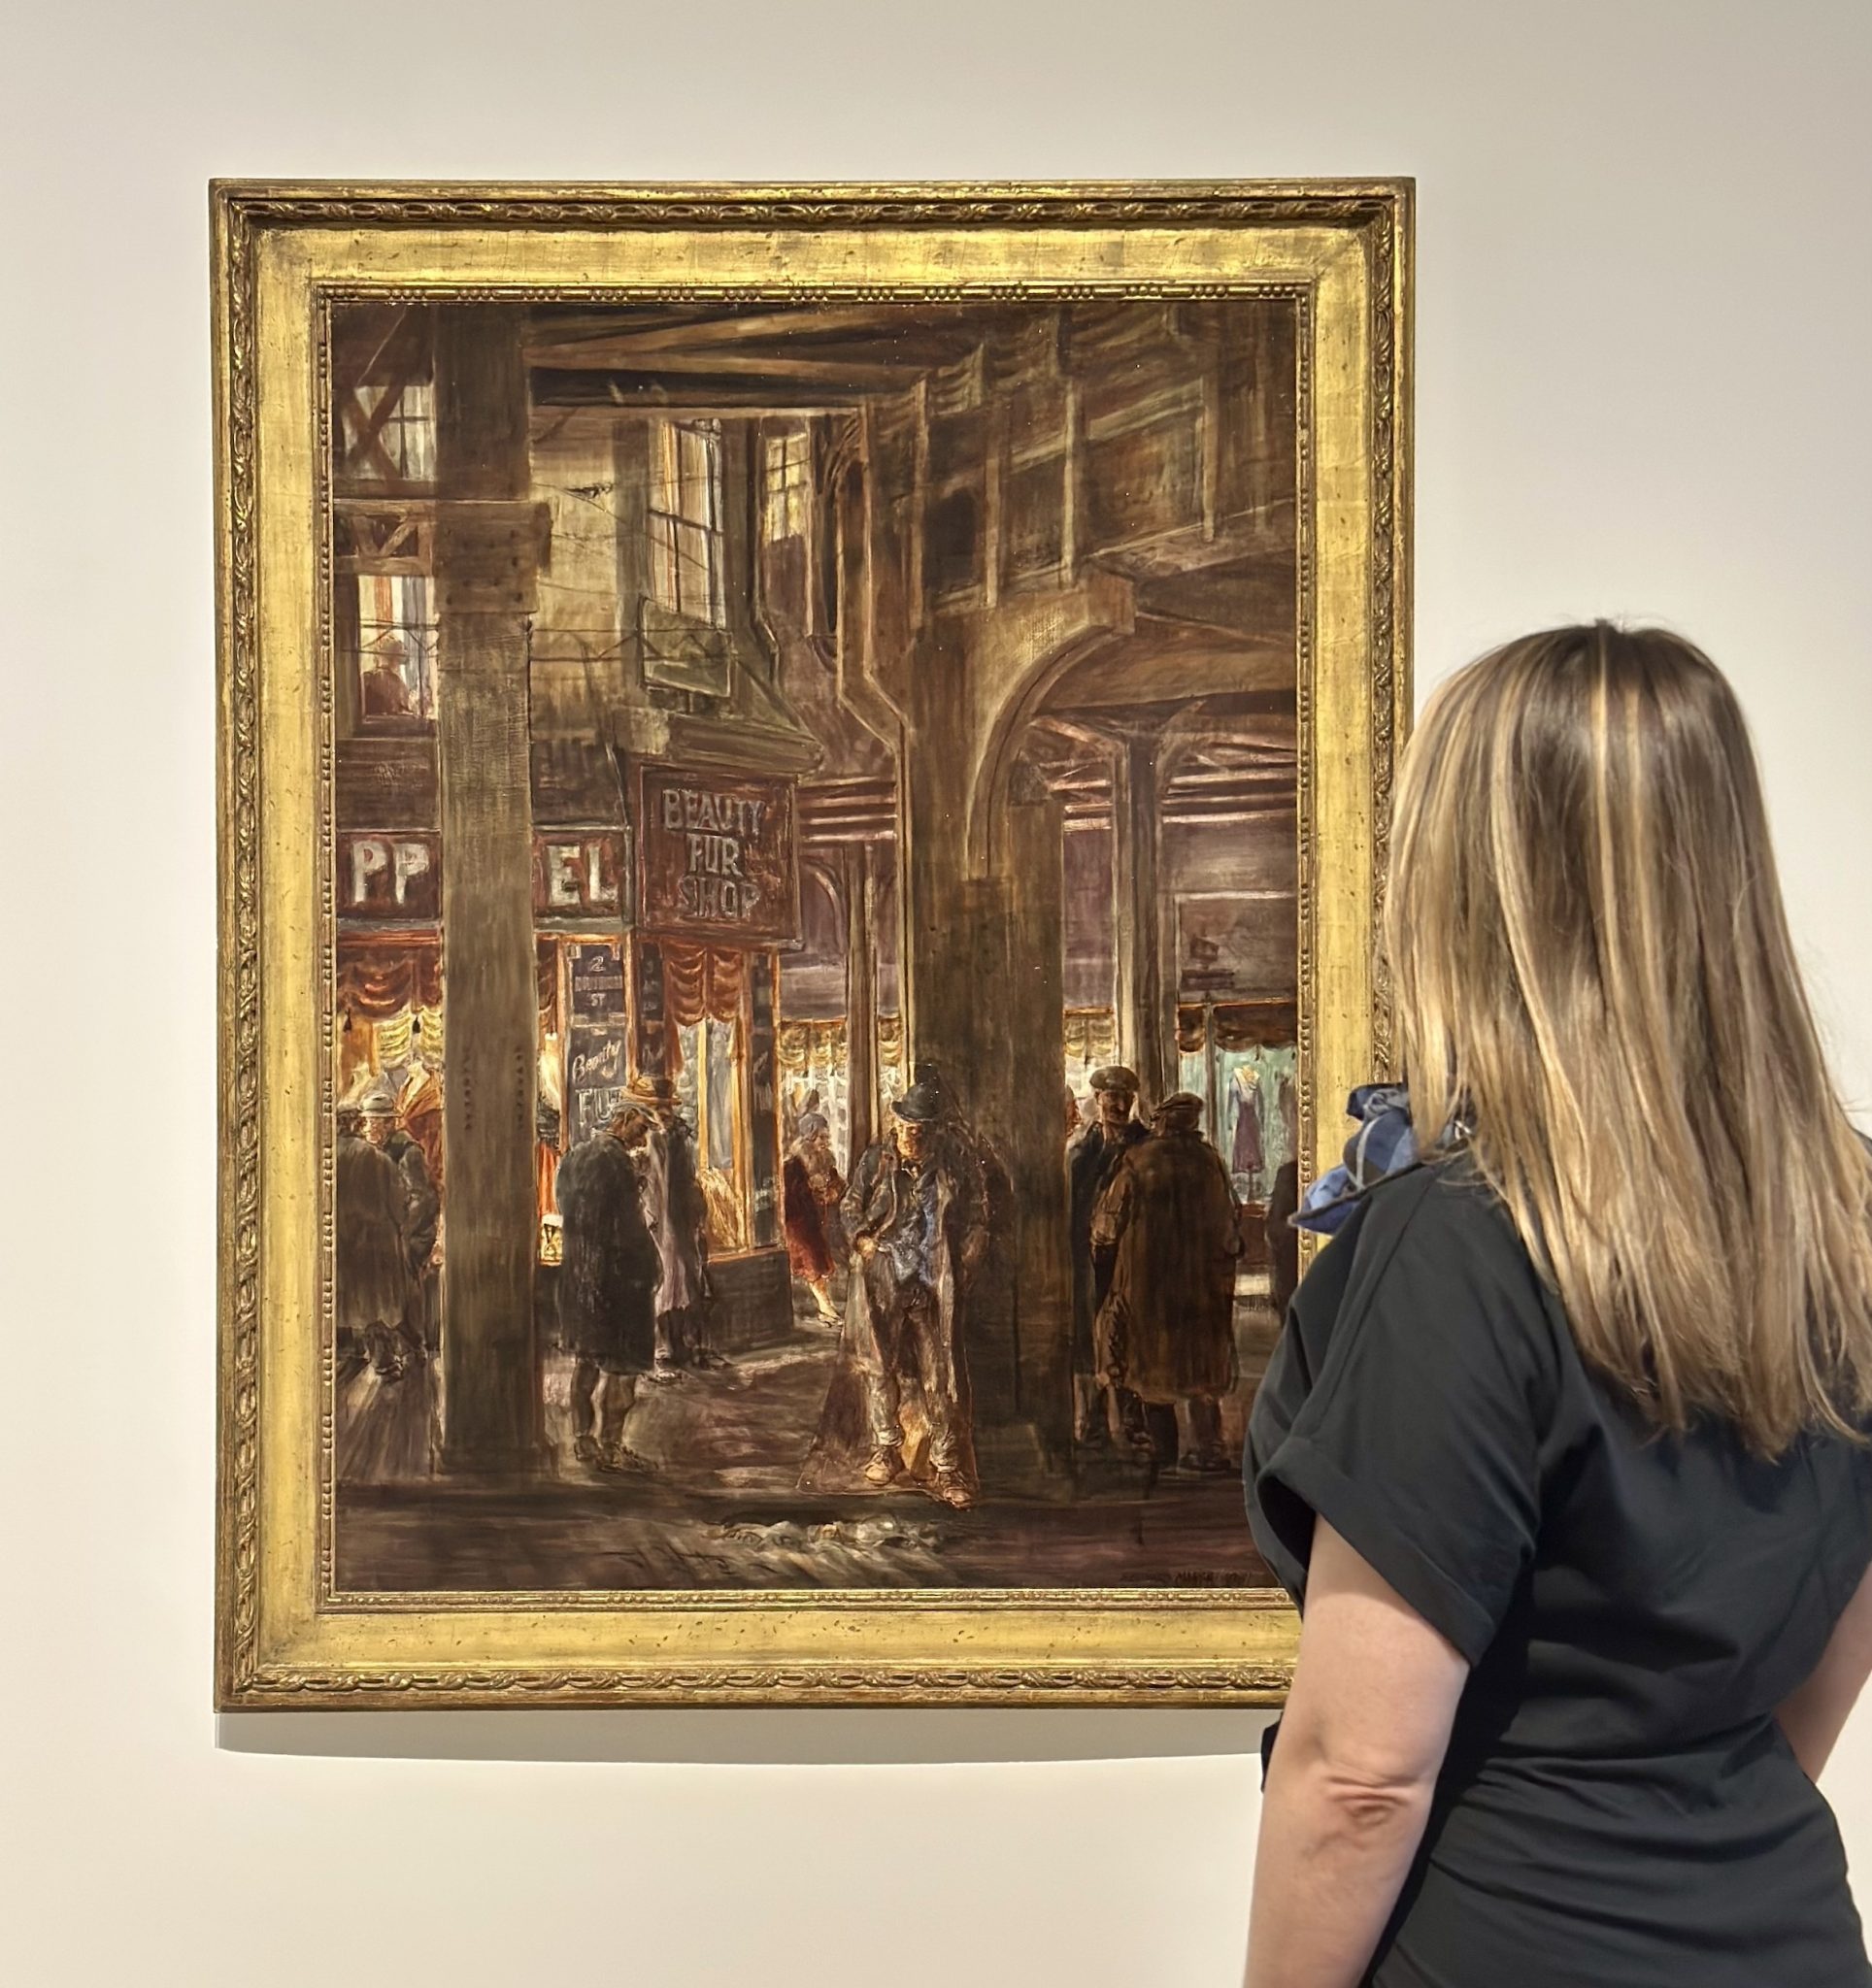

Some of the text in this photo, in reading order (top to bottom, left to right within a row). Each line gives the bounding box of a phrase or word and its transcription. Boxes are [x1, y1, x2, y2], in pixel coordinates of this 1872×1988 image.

[661, 788, 765, 842] BEAUTY
[351, 840, 618, 907] PP EL
[687, 833, 744, 878] FUR
[678, 876, 762, 921] SHOP
[590, 955, 606, 973] 2
